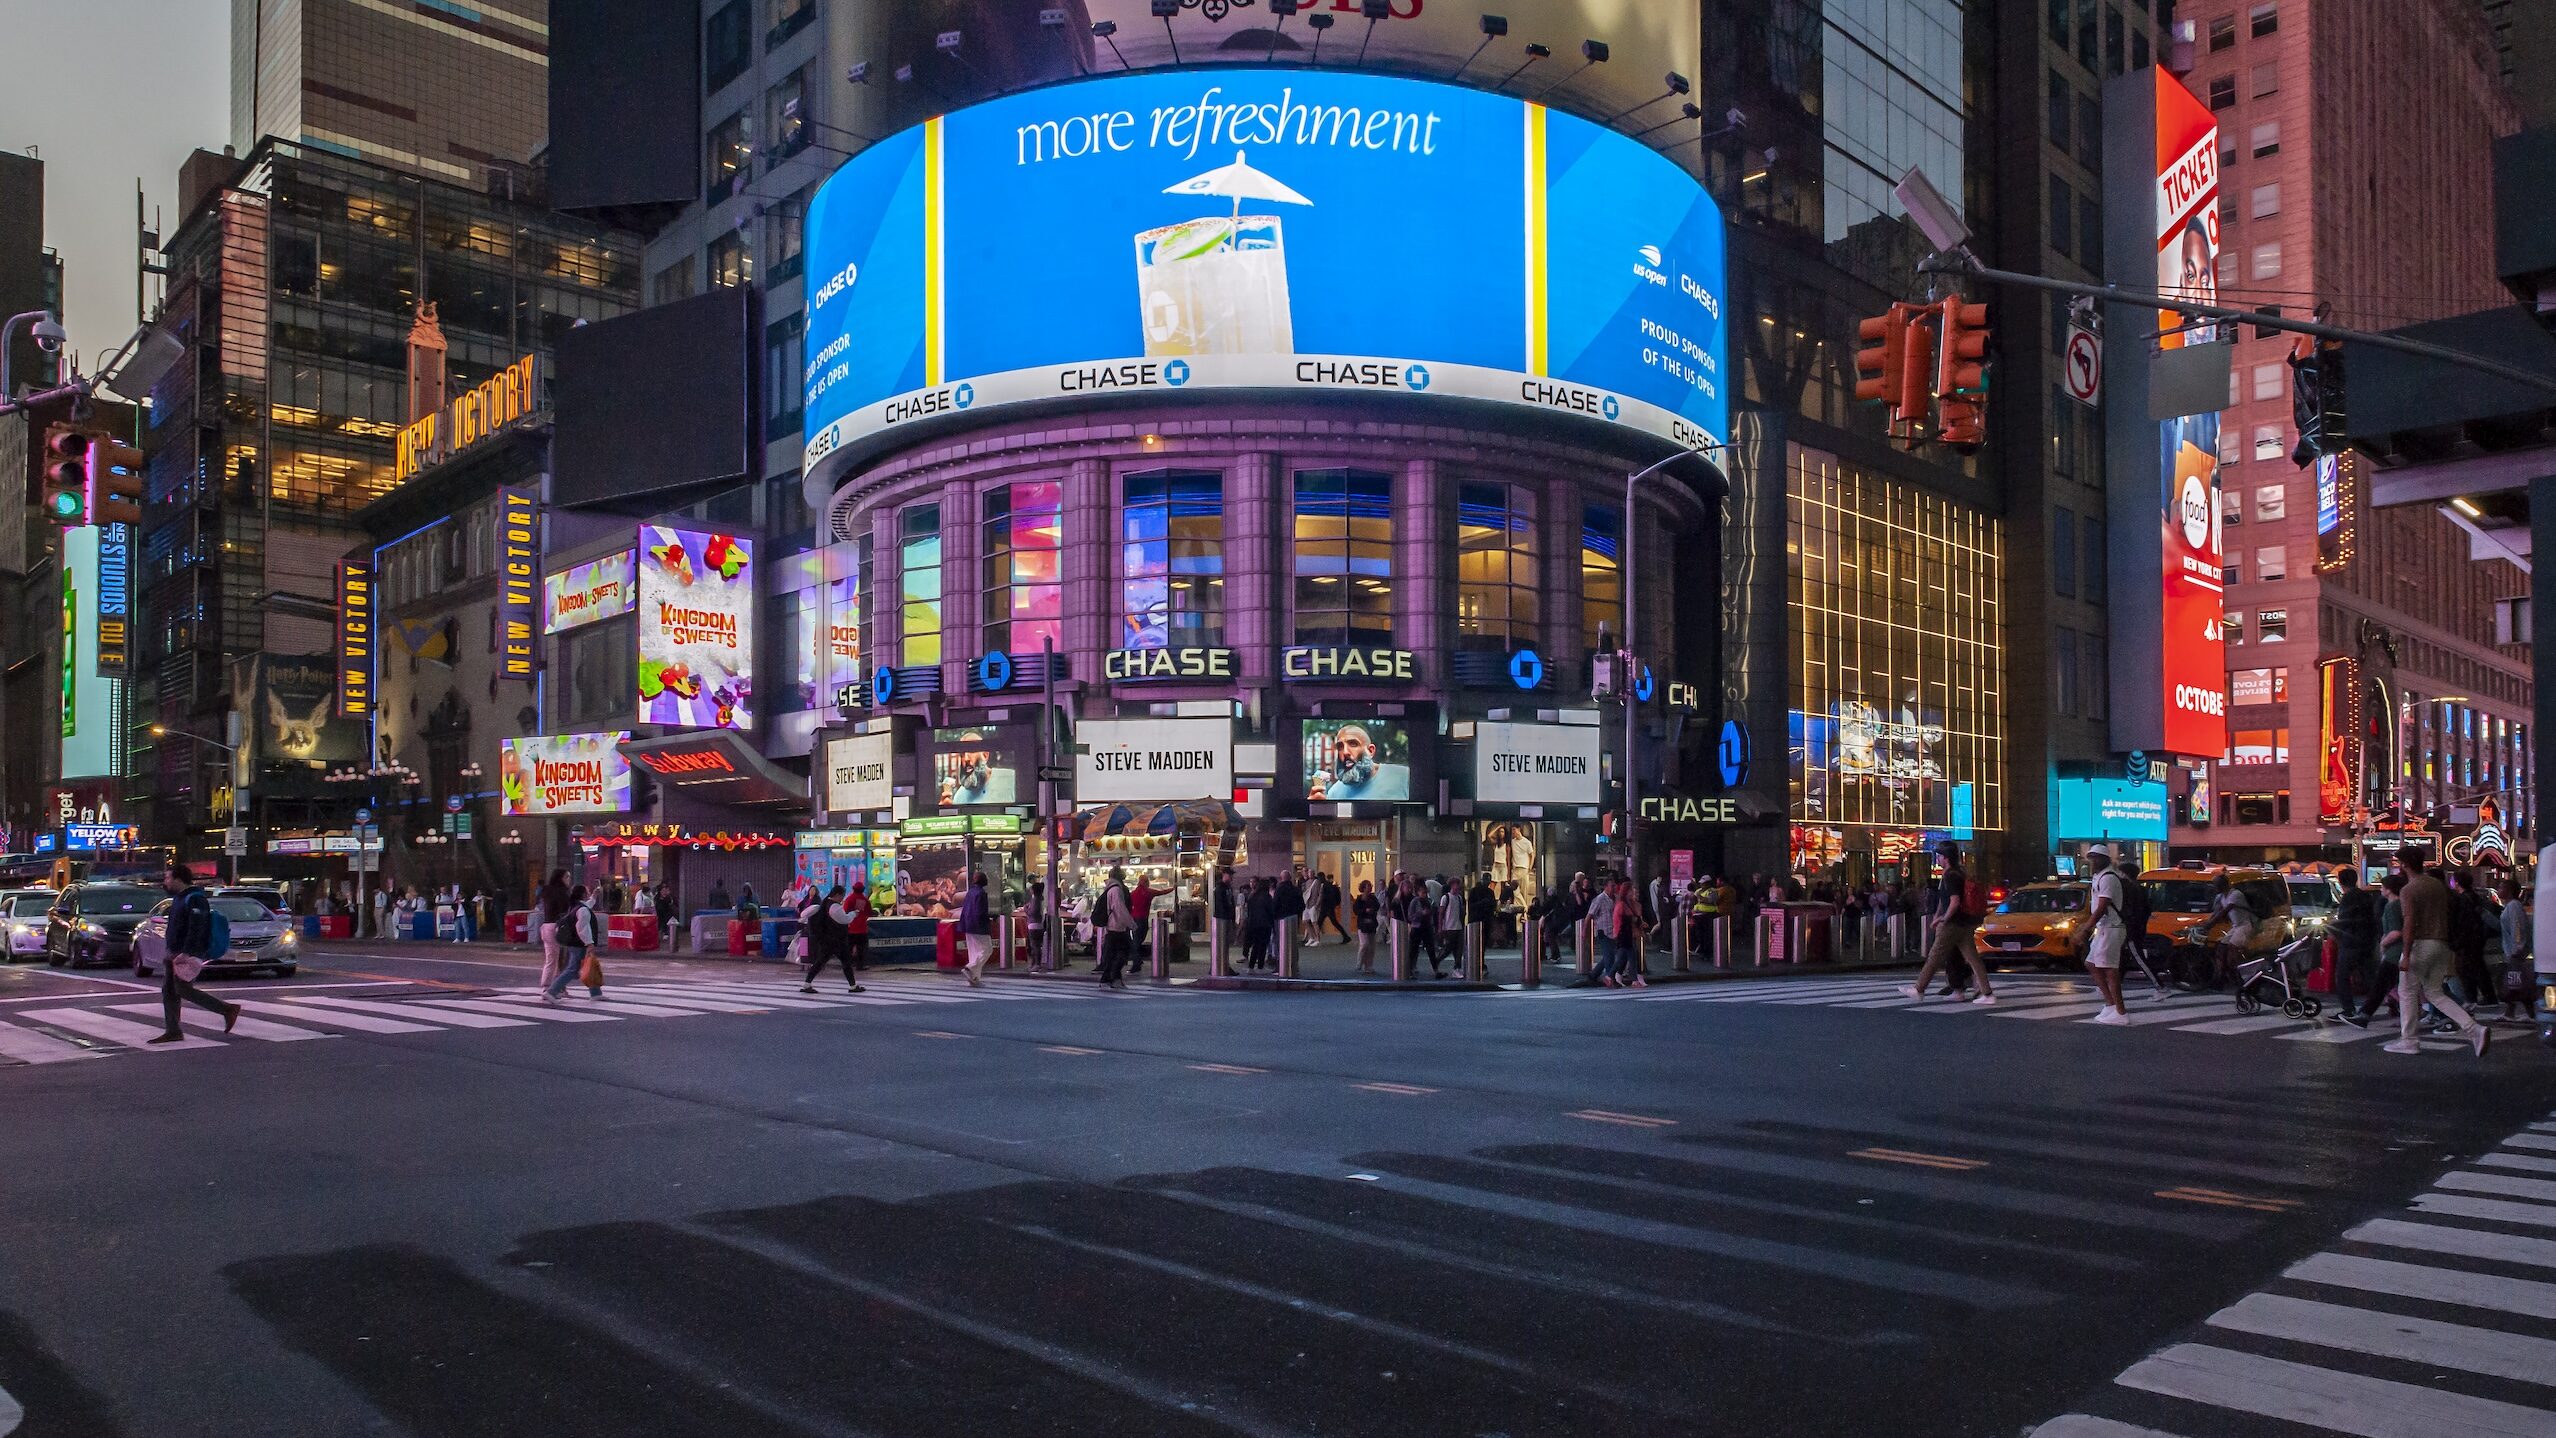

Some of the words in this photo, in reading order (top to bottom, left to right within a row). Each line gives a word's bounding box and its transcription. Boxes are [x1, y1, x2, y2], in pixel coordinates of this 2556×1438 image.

[1017, 110, 1134, 165] more
[1150, 87, 1440, 161] refreshment
[2163, 133, 2218, 216] TICKET
[816, 270, 845, 309] CHASE
[1633, 263, 1645, 277] us
[1645, 269, 1667, 287] open
[1681, 274, 1711, 313] CHASE
[816, 333, 850, 370] SPONSOR
[1641, 318, 1678, 348] PROUD
[1682, 338, 1715, 374] SPONSOR
[827, 362, 849, 387] OPEN
[1060, 364, 1157, 391] CHASE
[1296, 361, 1399, 387] CHASE
[1643, 348, 1659, 366] OF
[1662, 355, 1681, 378] THE
[1684, 366, 1695, 384] US
[1697, 375, 1715, 400] OPEN
[886, 389, 950, 424] CHASE
[1522, 381, 1598, 414] CHASE
[395, 412, 435, 481] NEW
[454, 354, 534, 449] ICTORY
[807, 432, 830, 467] CHASE
[1673, 420, 1709, 456] CHASE
[2319, 482, 2336, 500] TACO
[2183, 491, 2207, 526] food
[508, 494, 531, 605] VICTORY
[100, 544, 127, 615] STUDIOS
[2183, 555, 2197, 572] NEW
[2197, 558, 2213, 577] YORK
[346, 566, 367, 656] VICTORY
[558, 590, 588, 616] KINGDOM
[592, 581, 619, 605] SWEETS
[660, 602, 736, 630] KINGDOM
[100, 622, 124, 662] DUE
[508, 621, 531, 674] NEW
[673, 628, 737, 648] SWEETS
[1105, 648, 1231, 679] CHASE
[1285, 648, 1412, 679] CHASE
[346, 670, 366, 713] NEW
[2175, 684, 2223, 716] OCTOBE
[535, 758, 602, 786] KINGDOM
[836, 766, 855, 785] STEVE
[857, 763, 884, 782] MADDEN
[1095, 752, 1142, 771] STEVE
[1149, 751, 1213, 770] MADDEN
[1492, 754, 1531, 774] STEVE
[1536, 756, 1586, 775] MADDEN
[2149, 760, 2168, 782] AT&T
[545, 785, 602, 808] SWEETS
[1641, 798, 1737, 822] CHASE
[2102, 799, 2113, 807] Ask
[2102, 809, 2116, 819] right
[69, 829, 119, 838] YELLOW
[87, 838, 117, 846] FCE
[684, 832, 691, 840] A
[1312, 824, 1340, 836] STEVE
[1342, 825, 1378, 836] MADDEN
[2507, 971, 2522, 984] STK
